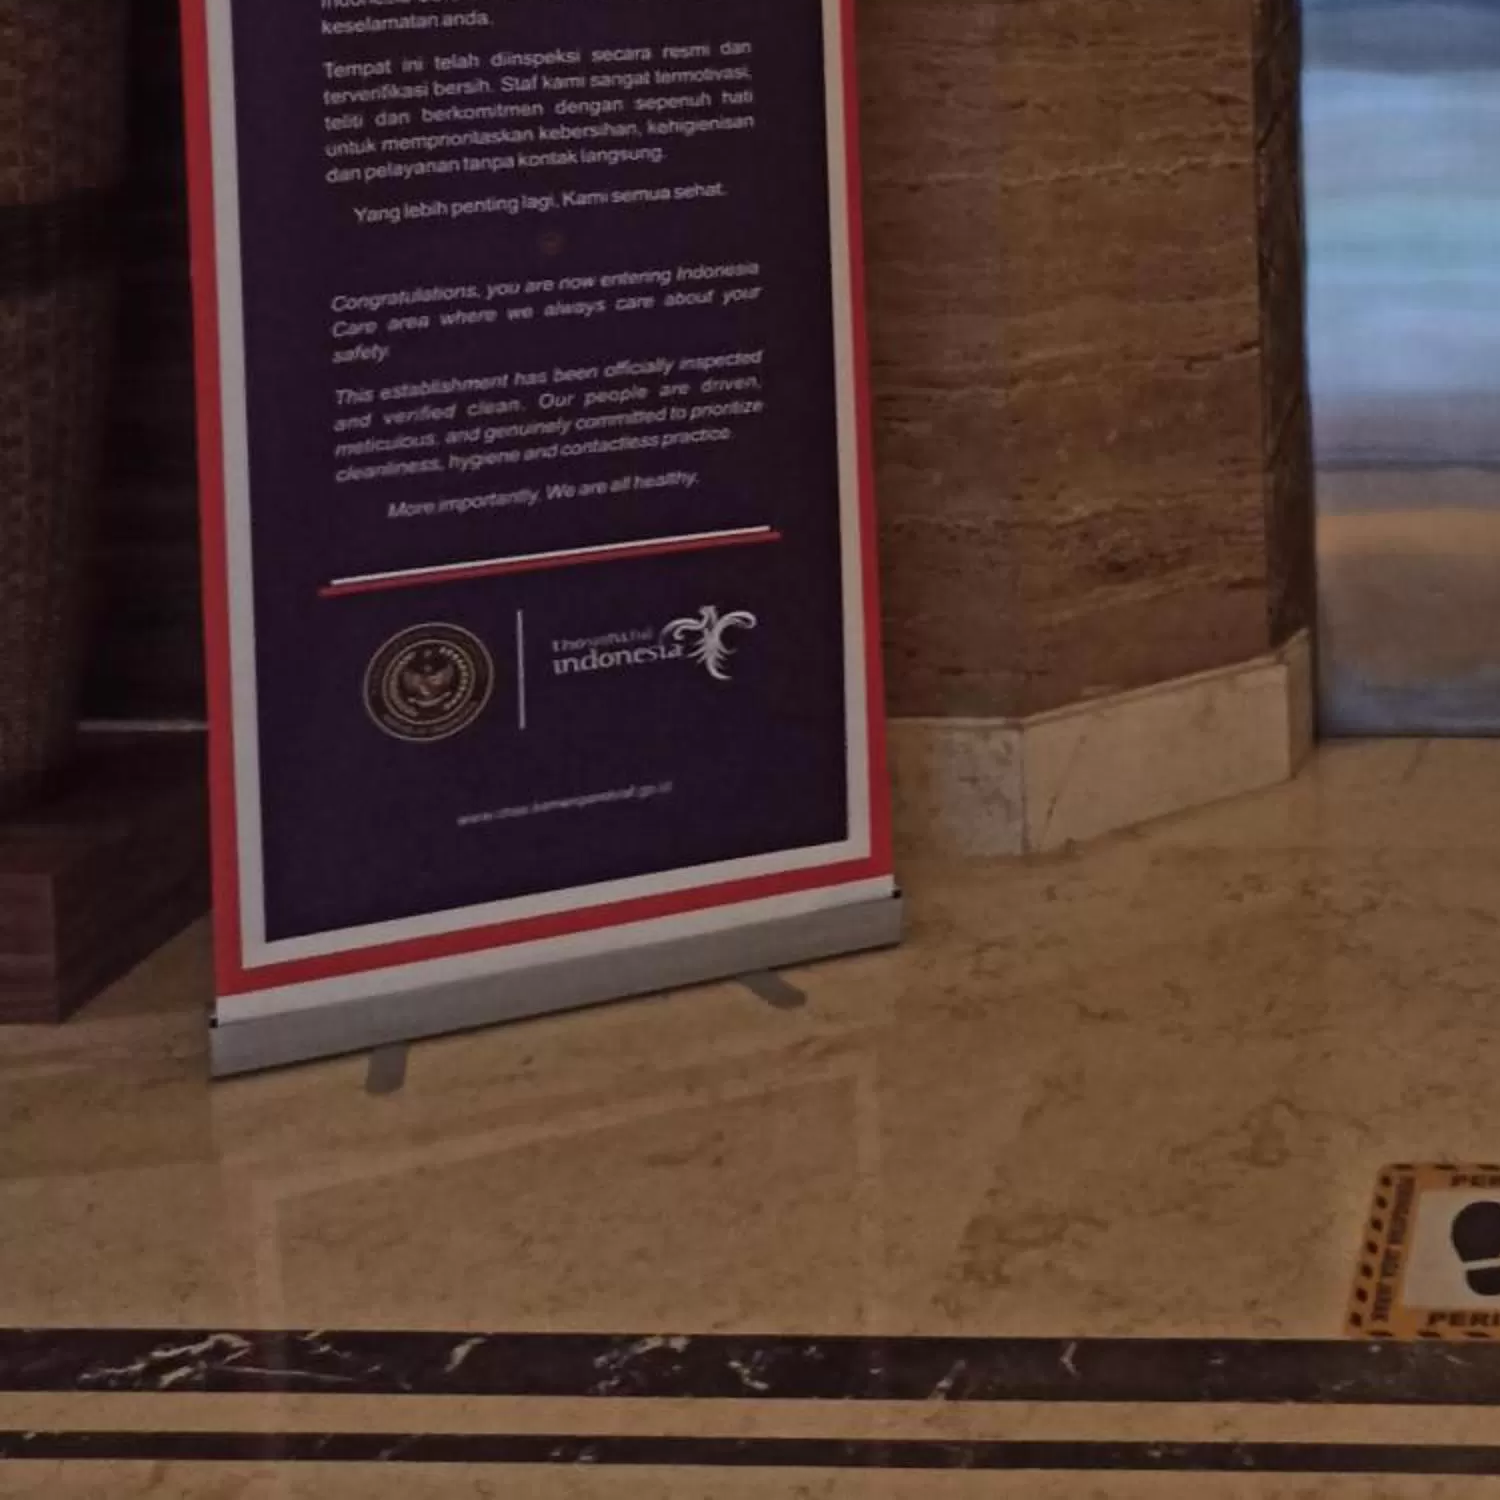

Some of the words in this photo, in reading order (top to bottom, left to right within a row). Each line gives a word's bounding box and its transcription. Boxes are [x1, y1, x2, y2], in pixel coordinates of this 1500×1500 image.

[320, 14, 438, 35] keselamatan
[322, 59, 391, 79] Tempat
[401, 59, 421, 72] ini
[434, 52, 479, 71] telah
[591, 47, 652, 63] secara
[661, 45, 711, 59] resmi
[719, 40, 751, 56] dan
[541, 75, 585, 90] kami
[589, 70, 650, 90] sangat
[374, 111, 410, 127] dan
[421, 102, 544, 123] berkomitmen
[554, 99, 624, 117] dengan
[634, 91, 711, 112] sepenuh
[721, 89, 753, 105] hati
[325, 137, 376, 158] untuk
[325, 167, 361, 184] dan
[363, 159, 460, 183] pelayanan
[462, 155, 514, 173] tanpa
[517, 149, 578, 167] kontak
[353, 206, 400, 224] Yang
[402, 200, 448, 219] lebih
[450, 197, 519, 218] penting
[561, 190, 608, 207] Kami
[610, 187, 671, 203] semua
[485, 283, 520, 301] you
[524, 279, 555, 294] are
[558, 276, 595, 290] now
[599, 269, 671, 288] entering
[675, 262, 759, 282] Indonesia
[332, 320, 378, 339] Care
[387, 315, 430, 332] area
[439, 309, 497, 327] where
[506, 306, 534, 321] we
[543, 299, 606, 317] always
[615, 295, 655, 311] care
[663, 289, 714, 307] about
[722, 286, 762, 306] your
[335, 388, 375, 405] This
[379, 373, 508, 401] establishment
[513, 371, 547, 386] has
[552, 366, 598, 384] been
[333, 412, 372, 433] and
[537, 392, 576, 410] Our
[583, 384, 648, 408] people
[659, 383, 691, 398] are
[444, 426, 481, 445] and
[669, 406, 687, 421] to
[523, 443, 558, 462] and
[545, 483, 576, 501] We
[578, 481, 608, 497] are
[552, 641, 685, 676] indonesia
